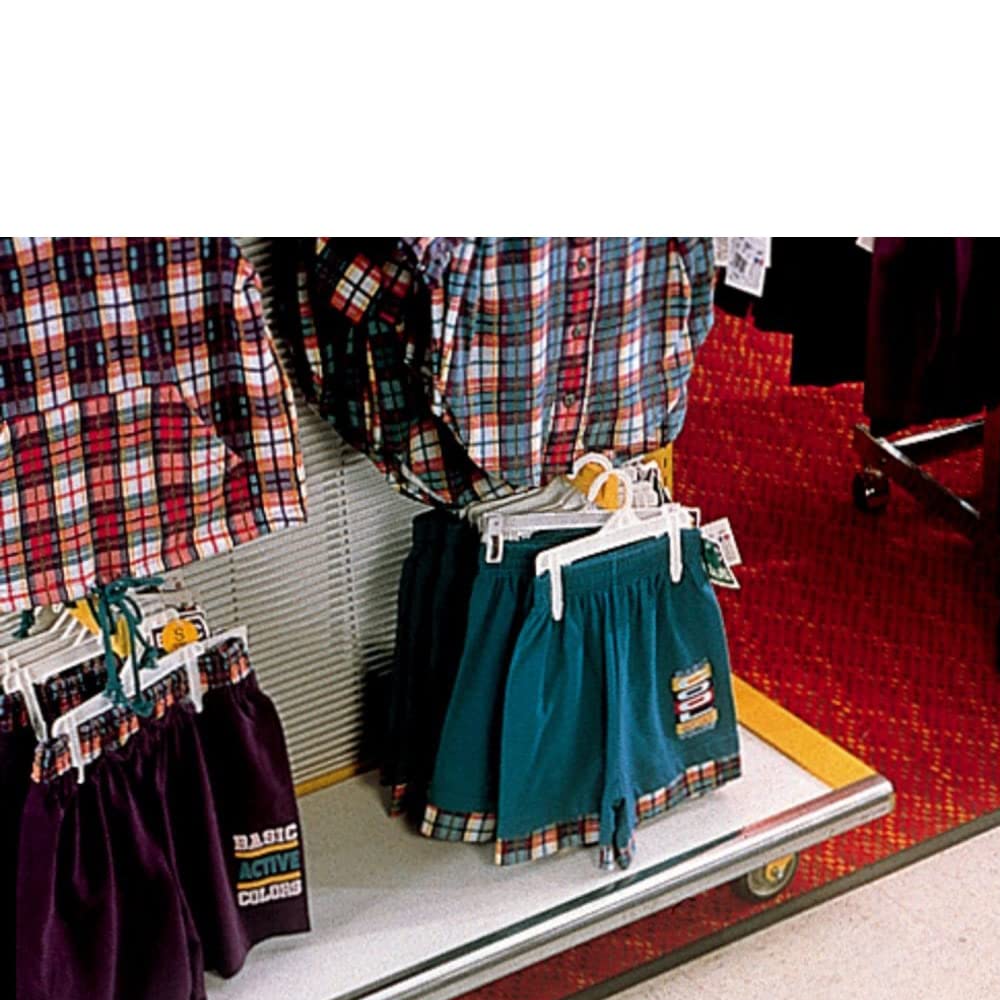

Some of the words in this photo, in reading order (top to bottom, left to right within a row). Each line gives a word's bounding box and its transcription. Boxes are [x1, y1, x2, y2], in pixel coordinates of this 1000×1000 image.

[232, 823, 299, 850] BASIC
[239, 849, 301, 879] ACTIVE
[236, 879, 303, 907] COLORS
